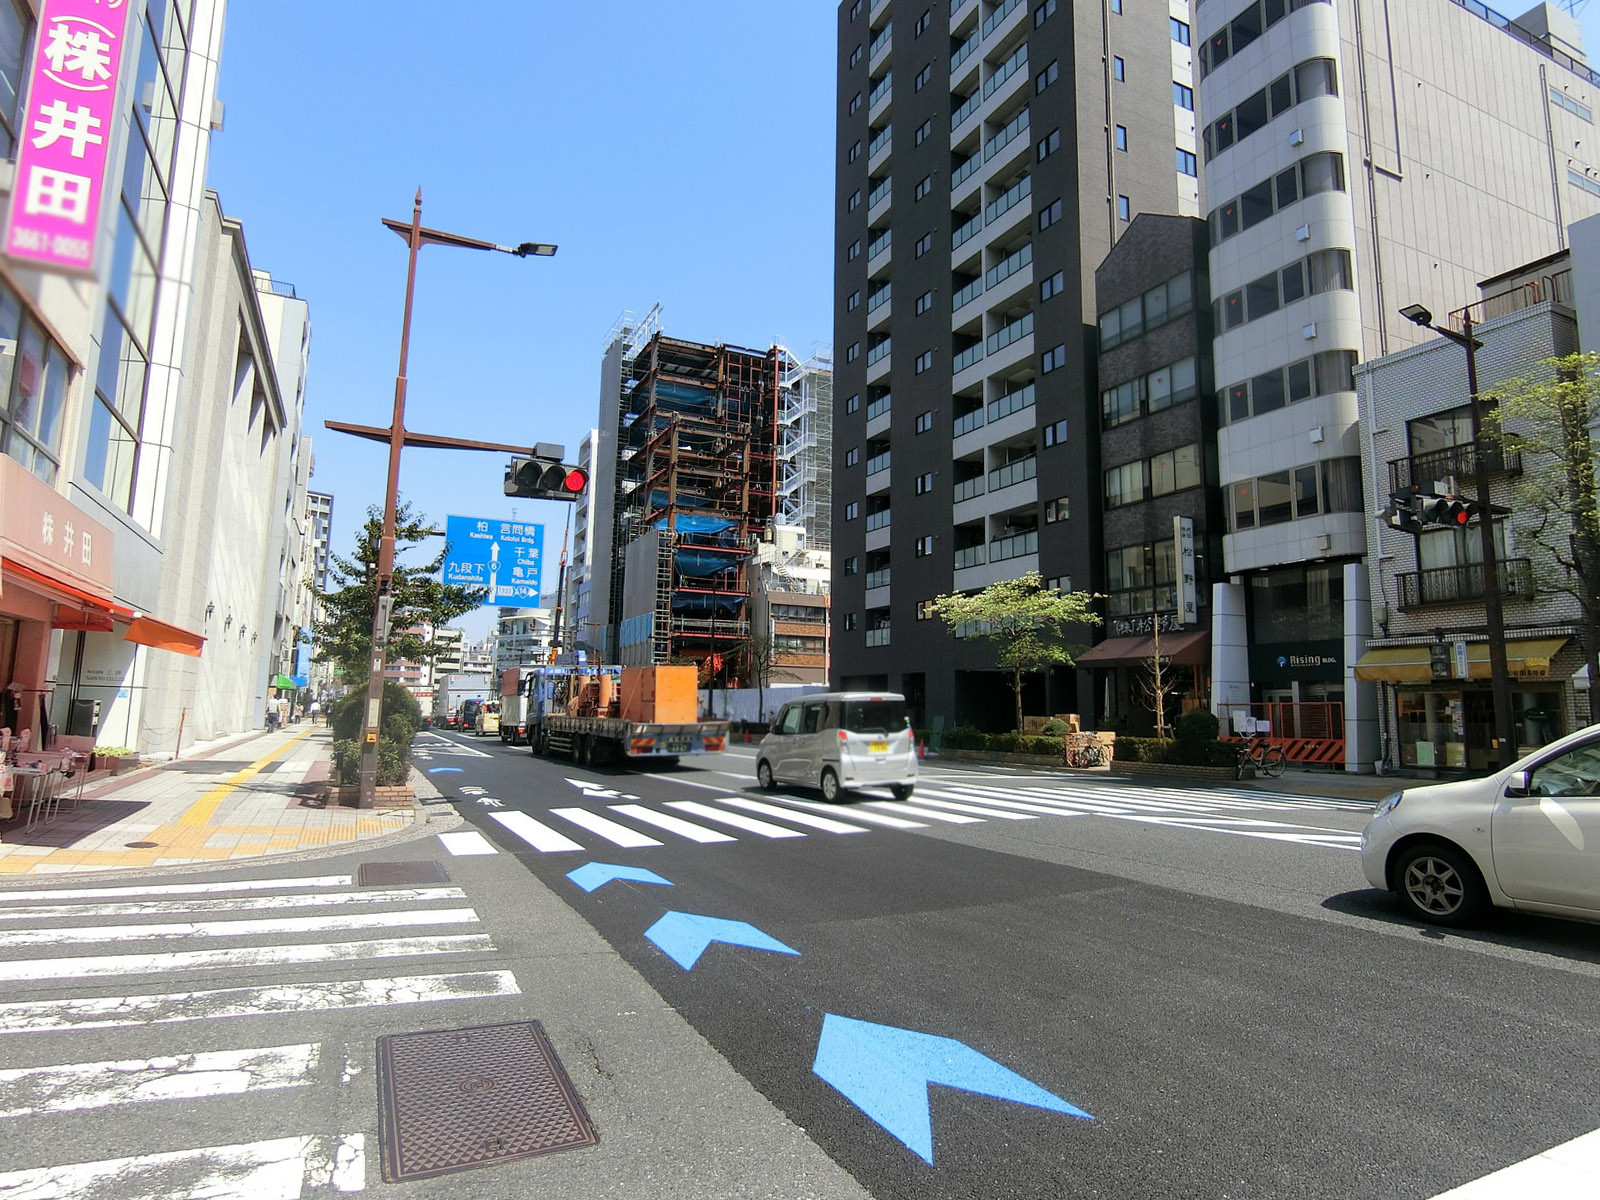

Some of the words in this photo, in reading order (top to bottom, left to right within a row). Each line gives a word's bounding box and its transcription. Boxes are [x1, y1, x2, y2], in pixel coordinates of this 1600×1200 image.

[25, 16, 116, 223] (株)井田
[477, 521, 488, 532] 柏
[514, 547, 539, 558] 千葉
[448, 562, 485, 574] 九段下
[1290, 655, 1321, 666] Rising
